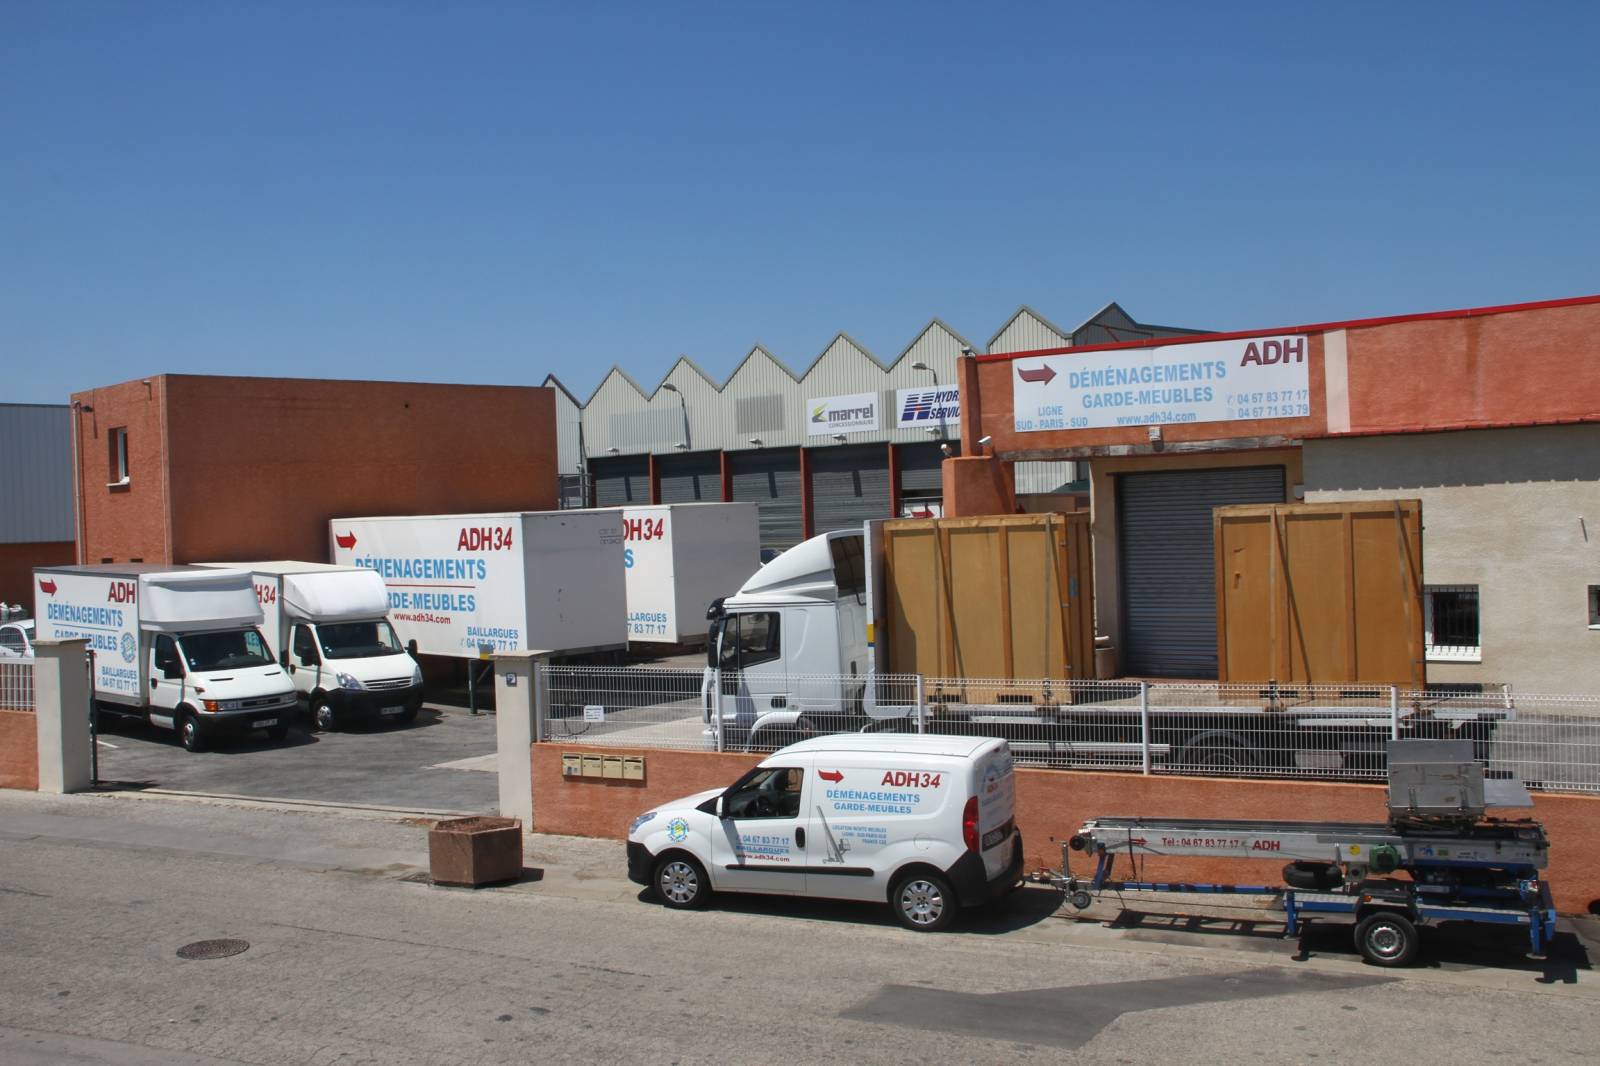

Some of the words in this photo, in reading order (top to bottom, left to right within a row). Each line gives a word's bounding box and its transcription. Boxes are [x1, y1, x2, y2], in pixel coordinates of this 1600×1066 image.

[1240, 338, 1304, 367] ADH
[1069, 360, 1226, 389] DÉMÉNAGEMENTS
[934, 390, 960, 403] HYDR
[1082, 386, 1213, 409] GARDE-MEUBLES
[1237, 393, 1249, 404] 04
[1267, 391, 1278, 402] 83
[1281, 390, 1293, 400] 77
[1296, 389, 1308, 400] 17
[828, 403, 873, 422] marrel
[930, 406, 960, 419] SERVIC
[1038, 405, 1064, 417] LIGNE
[1116, 411, 1197, 425] www.adh34.com
[1238, 407, 1249, 418] 04
[1252, 406, 1264, 417] 67
[1267, 406, 1278, 416] 71
[1282, 404, 1294, 415] 53
[1296, 404, 1308, 415] 79
[1015, 419, 1033, 430] SUD
[1039, 418, 1065, 429] PARIS
[1071, 416, 1089, 428] SUD
[624, 518, 664, 541] DH34
[457, 526, 513, 551] ADH34
[107, 581, 136, 604] ADH
[255, 584, 276, 605] H34
[386, 592, 476, 612] RDE-MEUBLES
[393, 611, 451, 625] www.adh34.com
[627, 612, 667, 623] LARGUES
[466, 626, 519, 639] BAILLARGUES
[634, 623, 644, 634] 83
[645, 624, 655, 635] 77
[657, 624, 667, 635] 17
[466, 638, 476, 648] 04
[498, 640, 507, 651] 77
[509, 640, 518, 651] 17
[881, 771, 941, 789] ADH34
[833, 802, 913, 814] GARDE-MEUBLES
[743, 835, 751, 843] 04
[752, 835, 761, 844] 67
[771, 836, 780, 845] 77
[1181, 838, 1191, 847] 04
[1193, 838, 1203, 848] 67
[1205, 838, 1215, 848] 83
[1217, 839, 1227, 848] 77
[1229, 839, 1239, 849] 17
[1251, 840, 1281, 851] ADH
